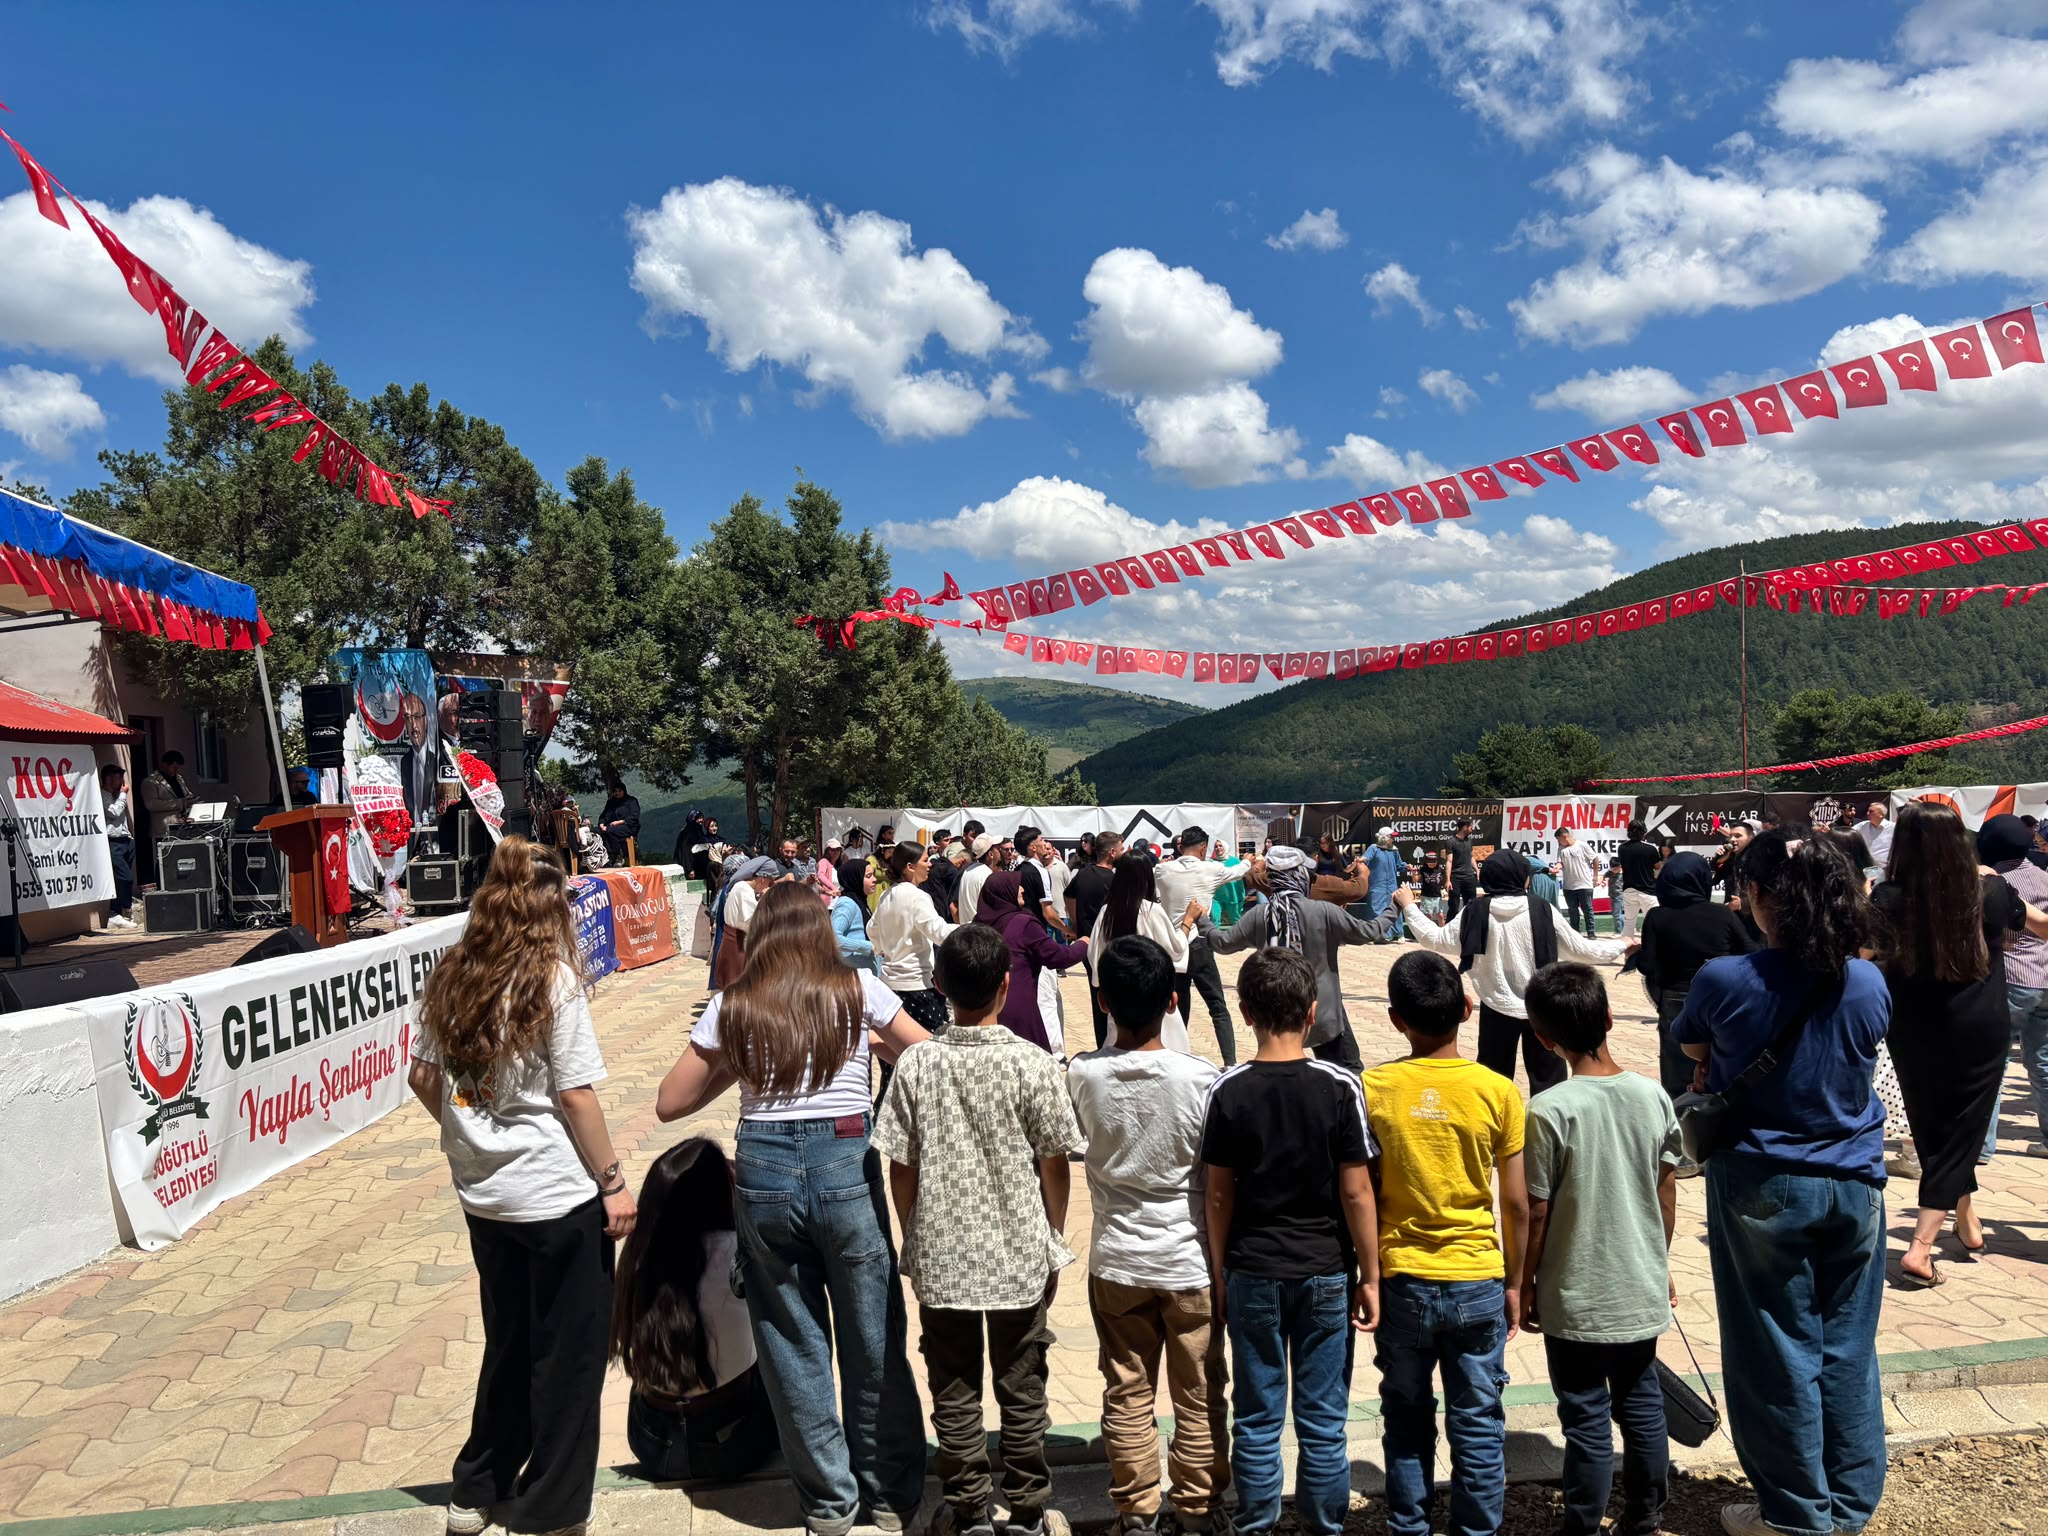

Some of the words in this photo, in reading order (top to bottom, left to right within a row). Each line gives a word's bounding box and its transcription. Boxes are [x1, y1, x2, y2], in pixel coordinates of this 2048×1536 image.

[12, 756, 76, 812] KOÇ
[356, 799, 394, 812] ELVAN
[1373, 806, 1395, 820] KOÇ
[1398, 803, 1503, 817] MANSUROĞULLARI
[1506, 803, 1632, 839] TAŞTANLAR
[1685, 810, 1759, 821] KARALAR
[1506, 840, 1551, 855] YAPI
[58, 850, 79, 869] Koç
[46, 878, 63, 896] 310
[66, 876, 78, 893] 37
[81, 874, 94, 890] 90
[221, 958, 409, 1071] GELENEKSEL
[238, 1074, 315, 1146] Yayla
[318, 1039, 397, 1122] Şenliğine
[166, 1120, 180, 1132] 1996
